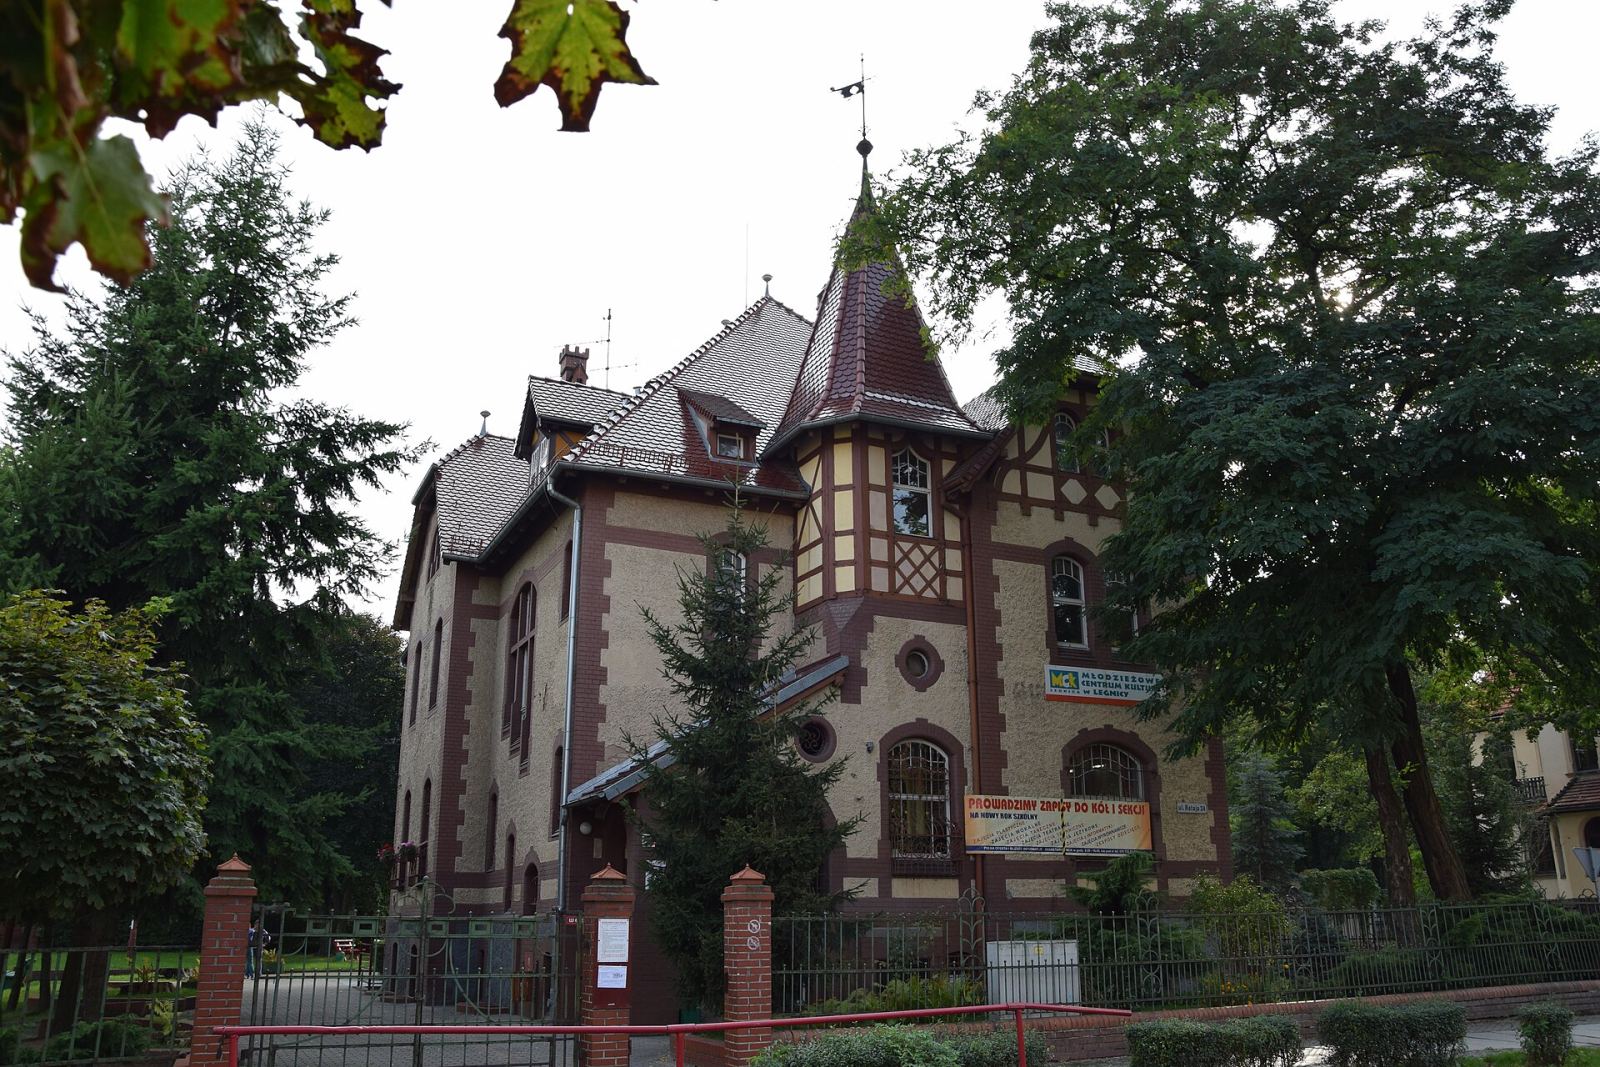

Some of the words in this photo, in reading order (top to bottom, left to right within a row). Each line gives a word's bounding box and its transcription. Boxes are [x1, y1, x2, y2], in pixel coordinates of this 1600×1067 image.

[1082, 680, 1122, 689] CENTRUM
[1124, 683, 1152, 692] KULTU
[968, 798, 1037, 810] PROWADZIMY
[1040, 801, 1071, 812] ZAPISY
[1074, 802, 1088, 813] DO
[1092, 801, 1109, 814] KÓŁ
[1112, 804, 1115, 814] I
[1118, 804, 1145, 815] SEKCJI
